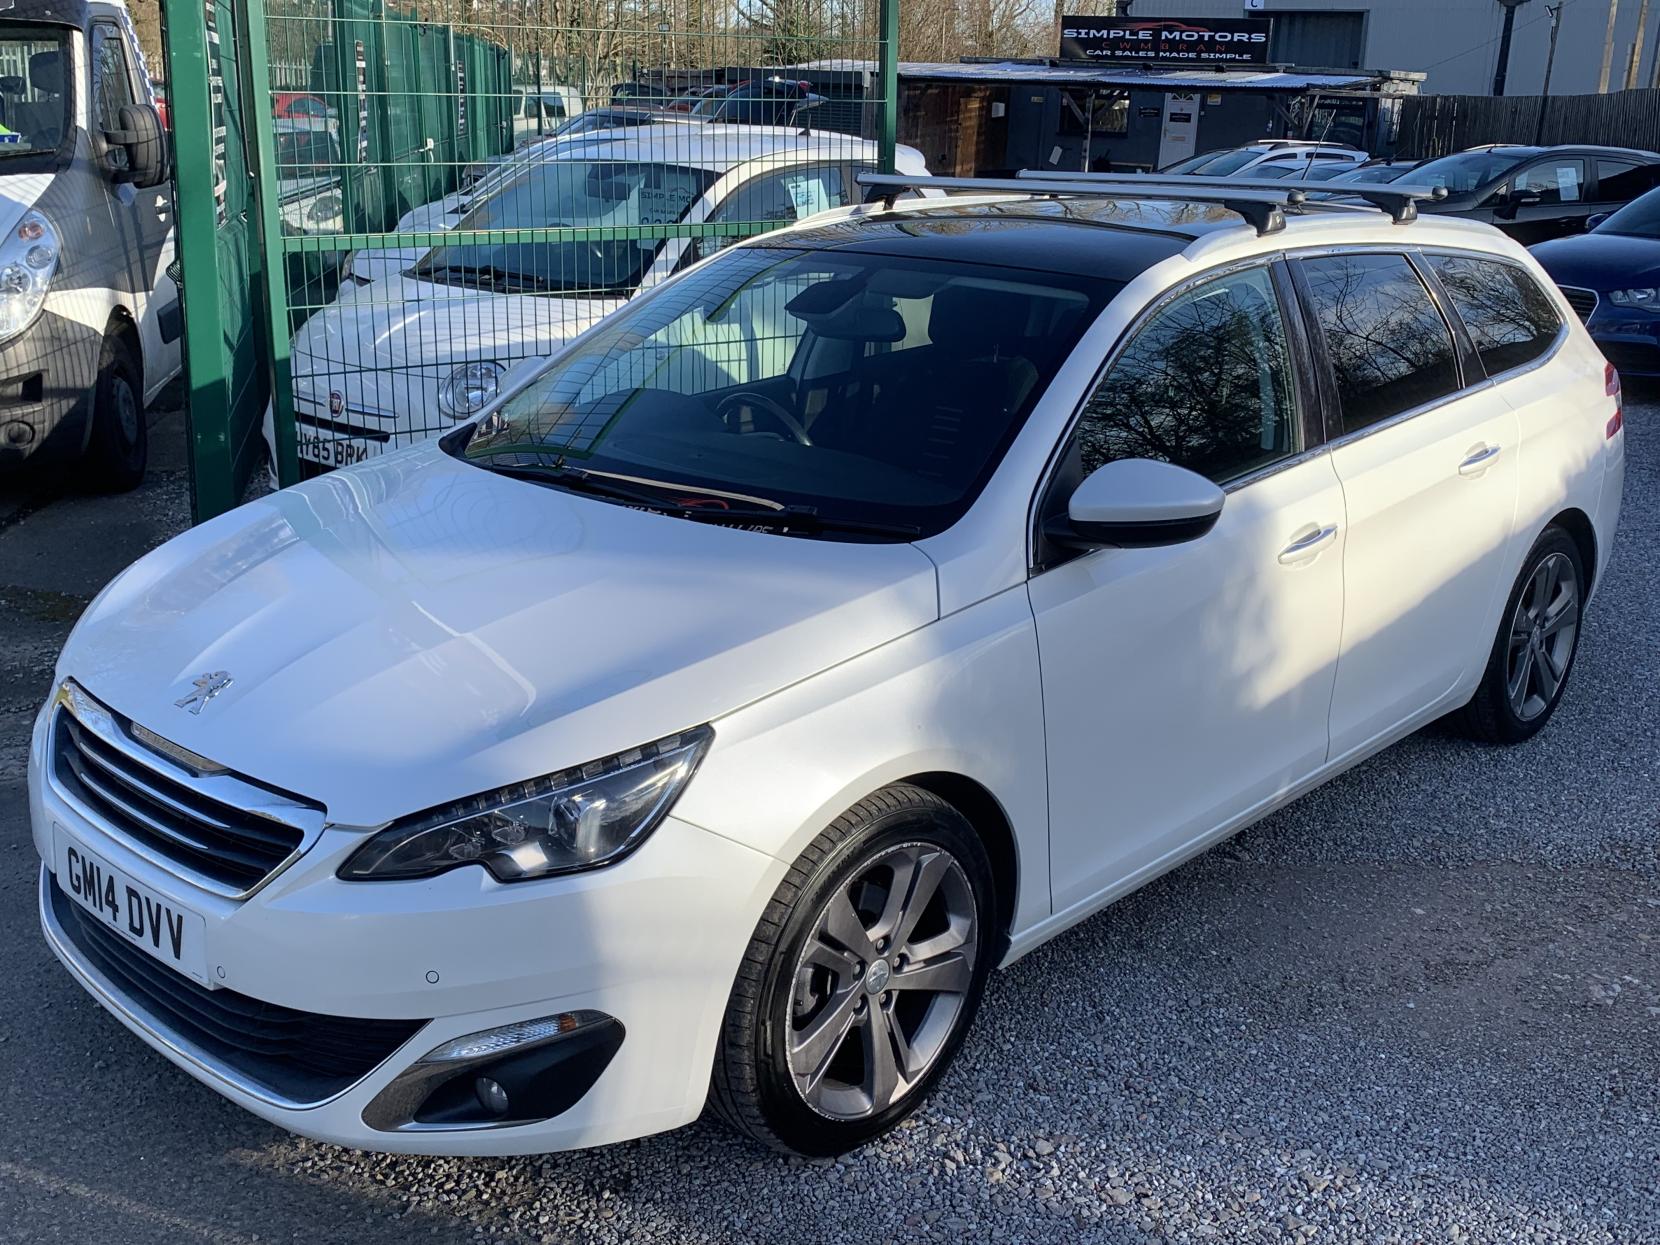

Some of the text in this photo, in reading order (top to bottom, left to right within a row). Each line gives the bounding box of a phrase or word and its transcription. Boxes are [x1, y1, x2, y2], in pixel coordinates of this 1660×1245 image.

[1063, 28, 1266, 42] SIMPLE MOTORS
[1102, 41, 1226, 51] CWMBRAN
[1200, 52, 1252, 60] SIMPLE
[67, 846, 183, 960] GM14 DVV
